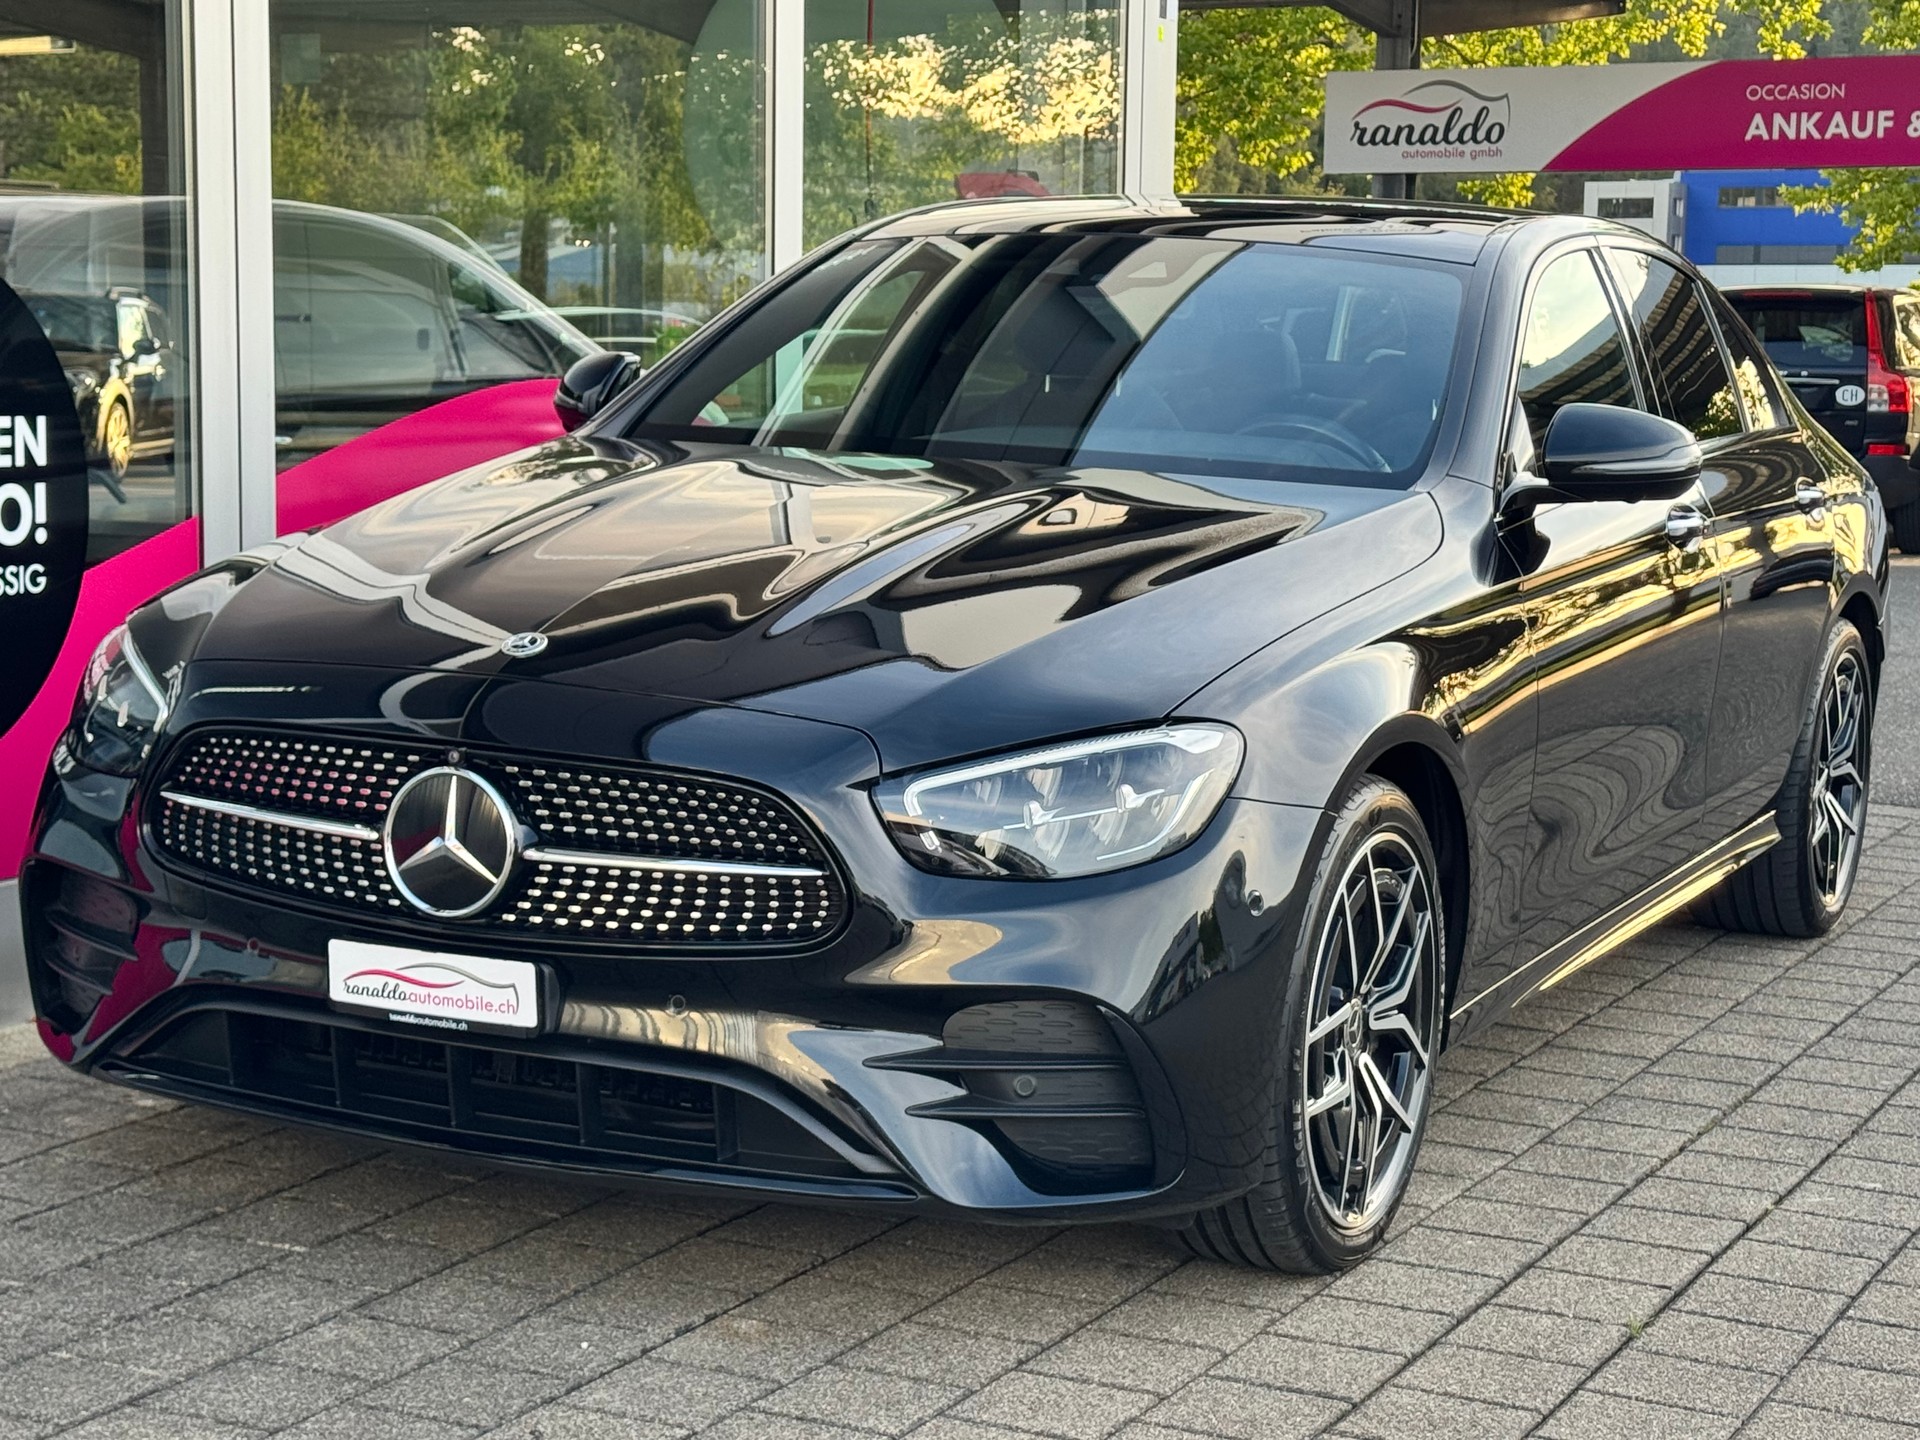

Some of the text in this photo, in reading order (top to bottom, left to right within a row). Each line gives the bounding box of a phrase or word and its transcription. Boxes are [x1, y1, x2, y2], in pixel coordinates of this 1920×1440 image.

[1746, 83, 1846, 101] OCCASION
[1350, 105, 1505, 146] ranaldo
[1744, 110, 1895, 141] ANKAUF
[1401, 147, 1503, 160] automobile gmbh
[1842, 389, 1858, 402] CH
[0, 482, 48, 547] O!
[343, 981, 517, 1014] ranaldoautomobile.ch
[1292, 1099, 1309, 1186] EAGLE
